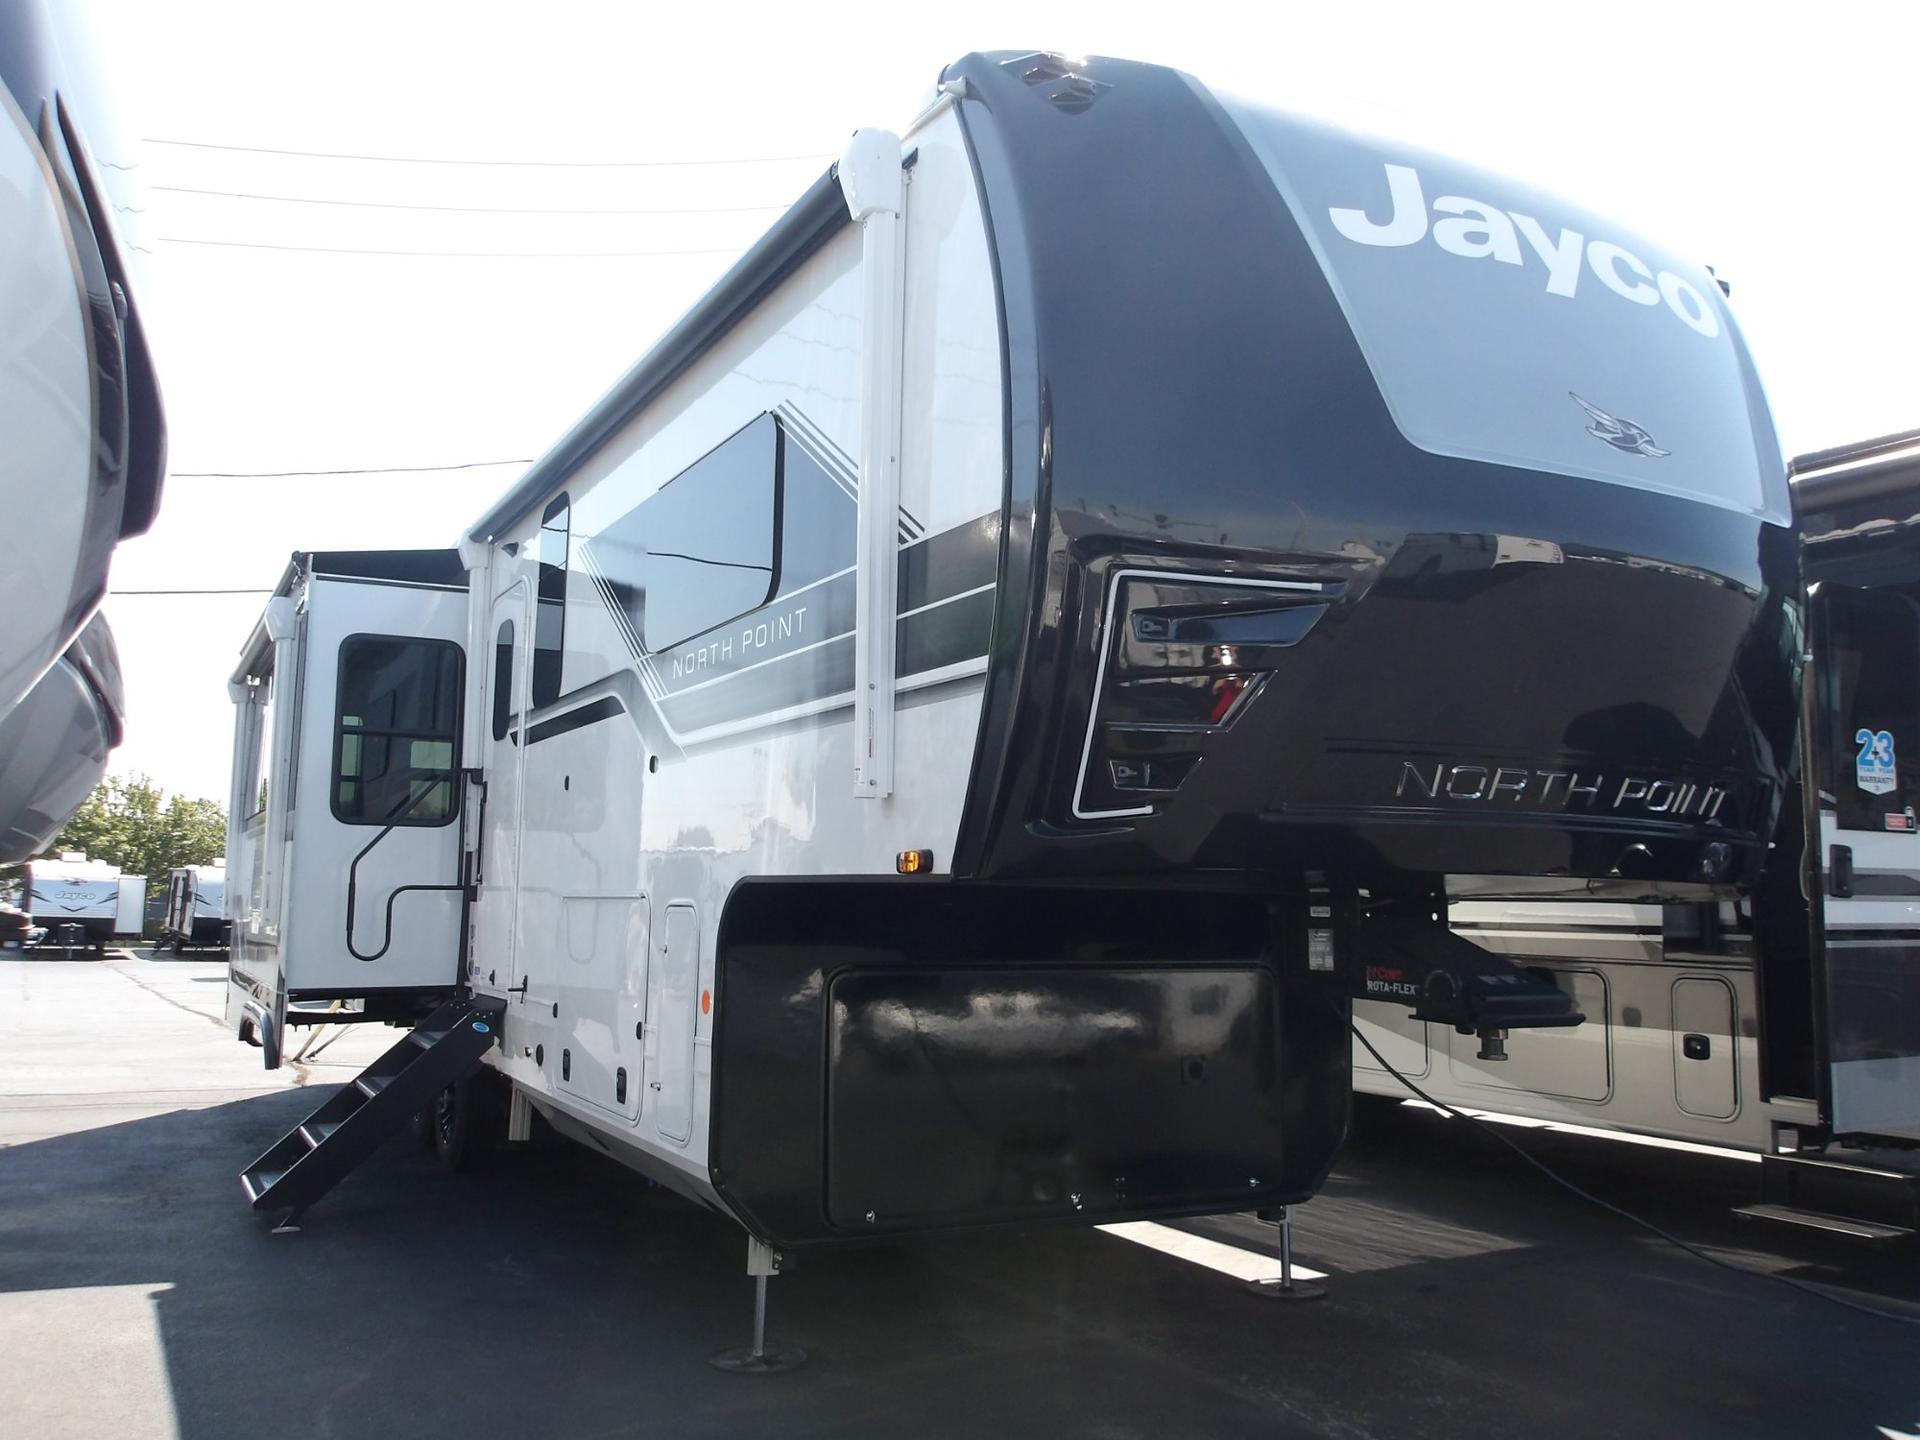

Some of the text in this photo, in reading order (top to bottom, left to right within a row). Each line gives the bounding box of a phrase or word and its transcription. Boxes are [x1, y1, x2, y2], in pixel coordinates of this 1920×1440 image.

[1328, 163, 1719, 338] Jayco
[672, 608, 807, 680] NORTH POINT
[1395, 761, 1728, 818] NORTH POINT
[1859, 775, 1894, 784] WARRANTY
[55, 890, 97, 901] Jayco
[1367, 980, 1416, 995] ROTA-FLEX
